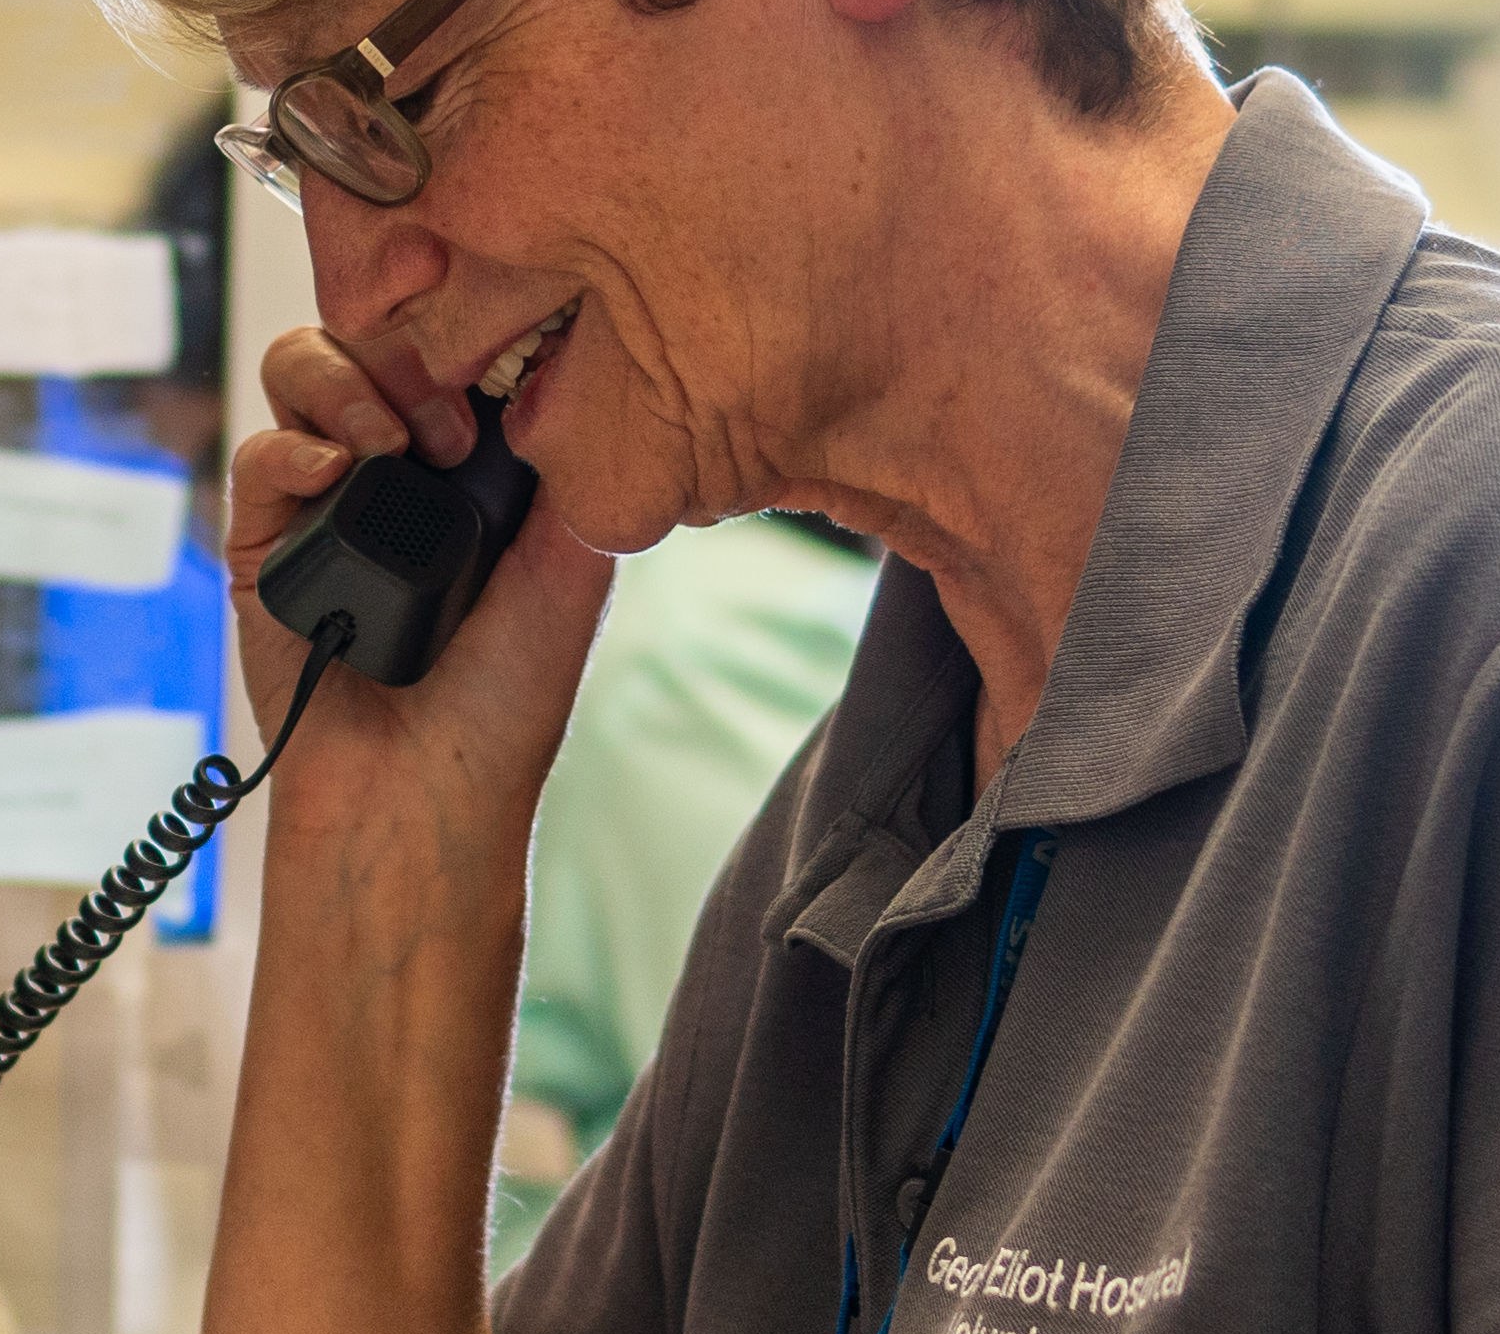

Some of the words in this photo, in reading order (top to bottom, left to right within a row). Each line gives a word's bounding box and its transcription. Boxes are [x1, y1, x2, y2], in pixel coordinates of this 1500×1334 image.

[928, 1237, 986, 1298] Geo
[983, 1247, 1065, 1310] Eliot
[1069, 1241, 1192, 1317] Hostal
